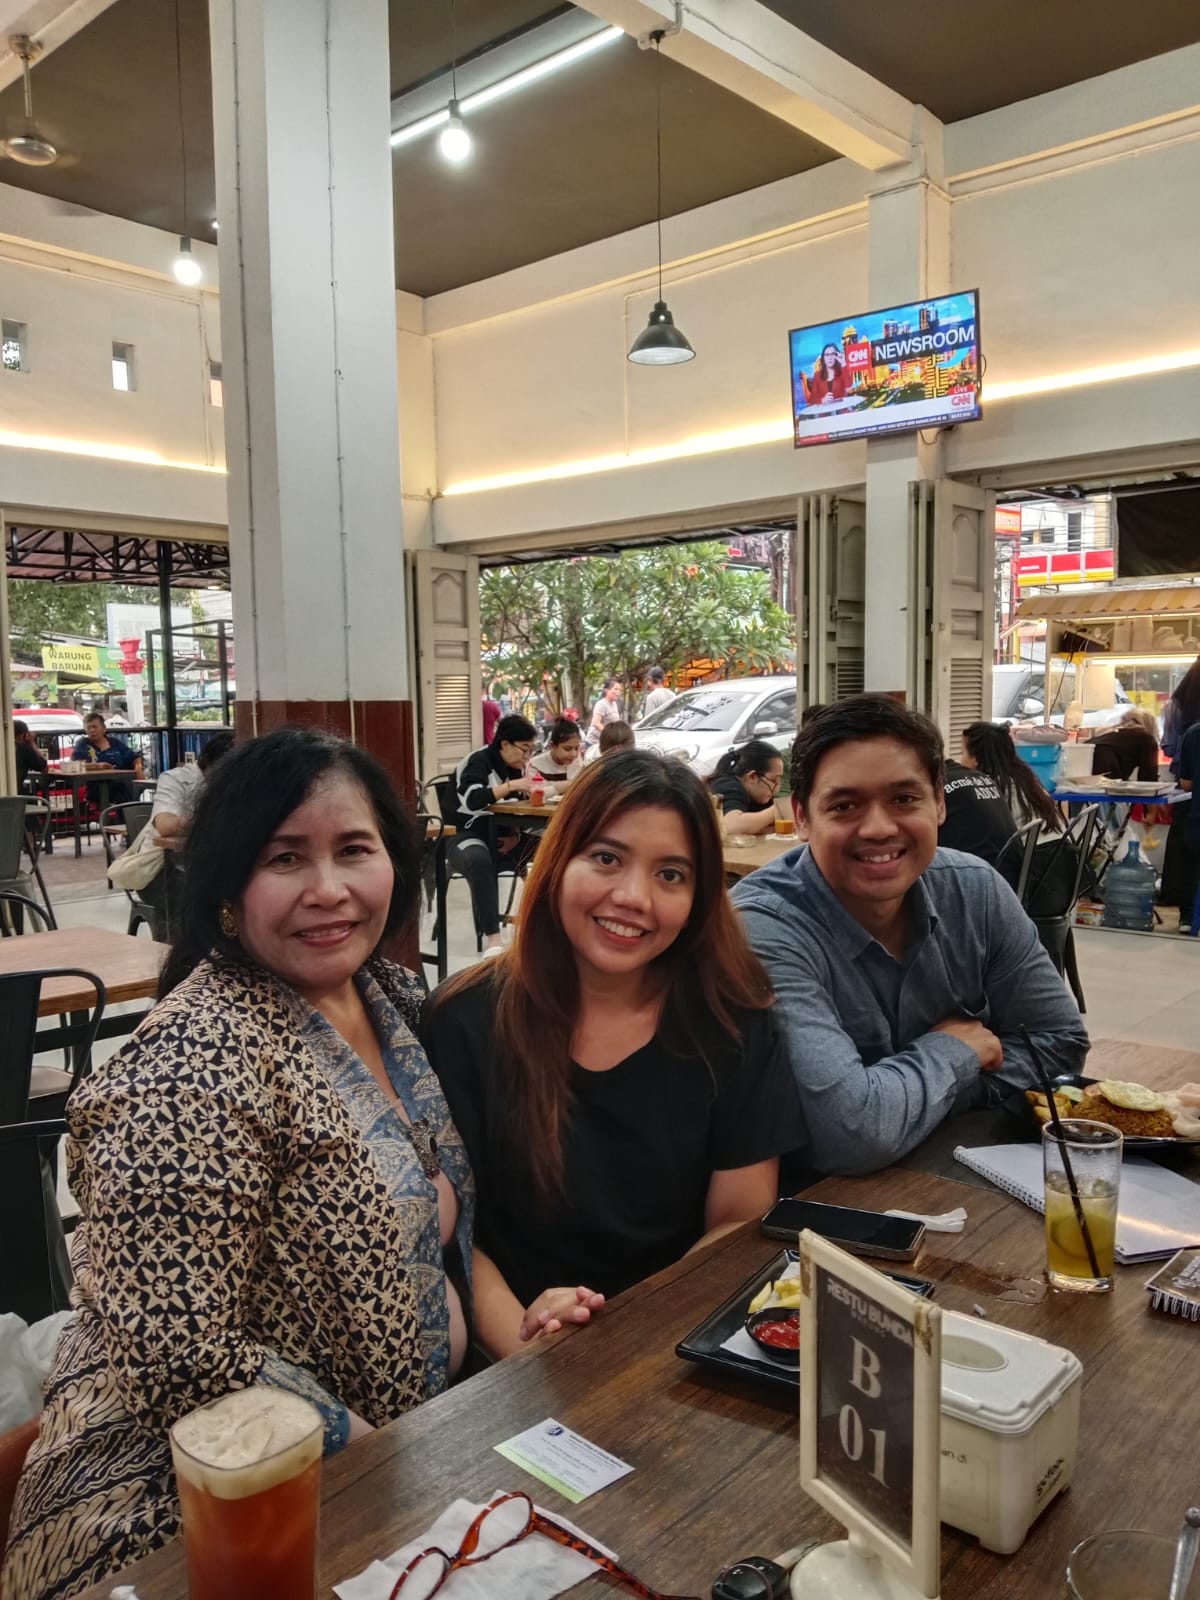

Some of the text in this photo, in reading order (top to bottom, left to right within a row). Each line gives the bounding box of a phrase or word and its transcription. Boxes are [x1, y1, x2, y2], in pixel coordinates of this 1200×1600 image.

[848, 324, 975, 362] CNN NEWSROOM
[951, 394, 971, 406] CNN
[48, 650, 92, 661] WARUNG
[52, 662, 92, 671] BARUNA
[827, 1277, 867, 1316] RESTU
[867, 1304, 913, 1347] BUNDA
[849, 1335, 882, 1399] B
[838, 1404, 889, 1488] 01
